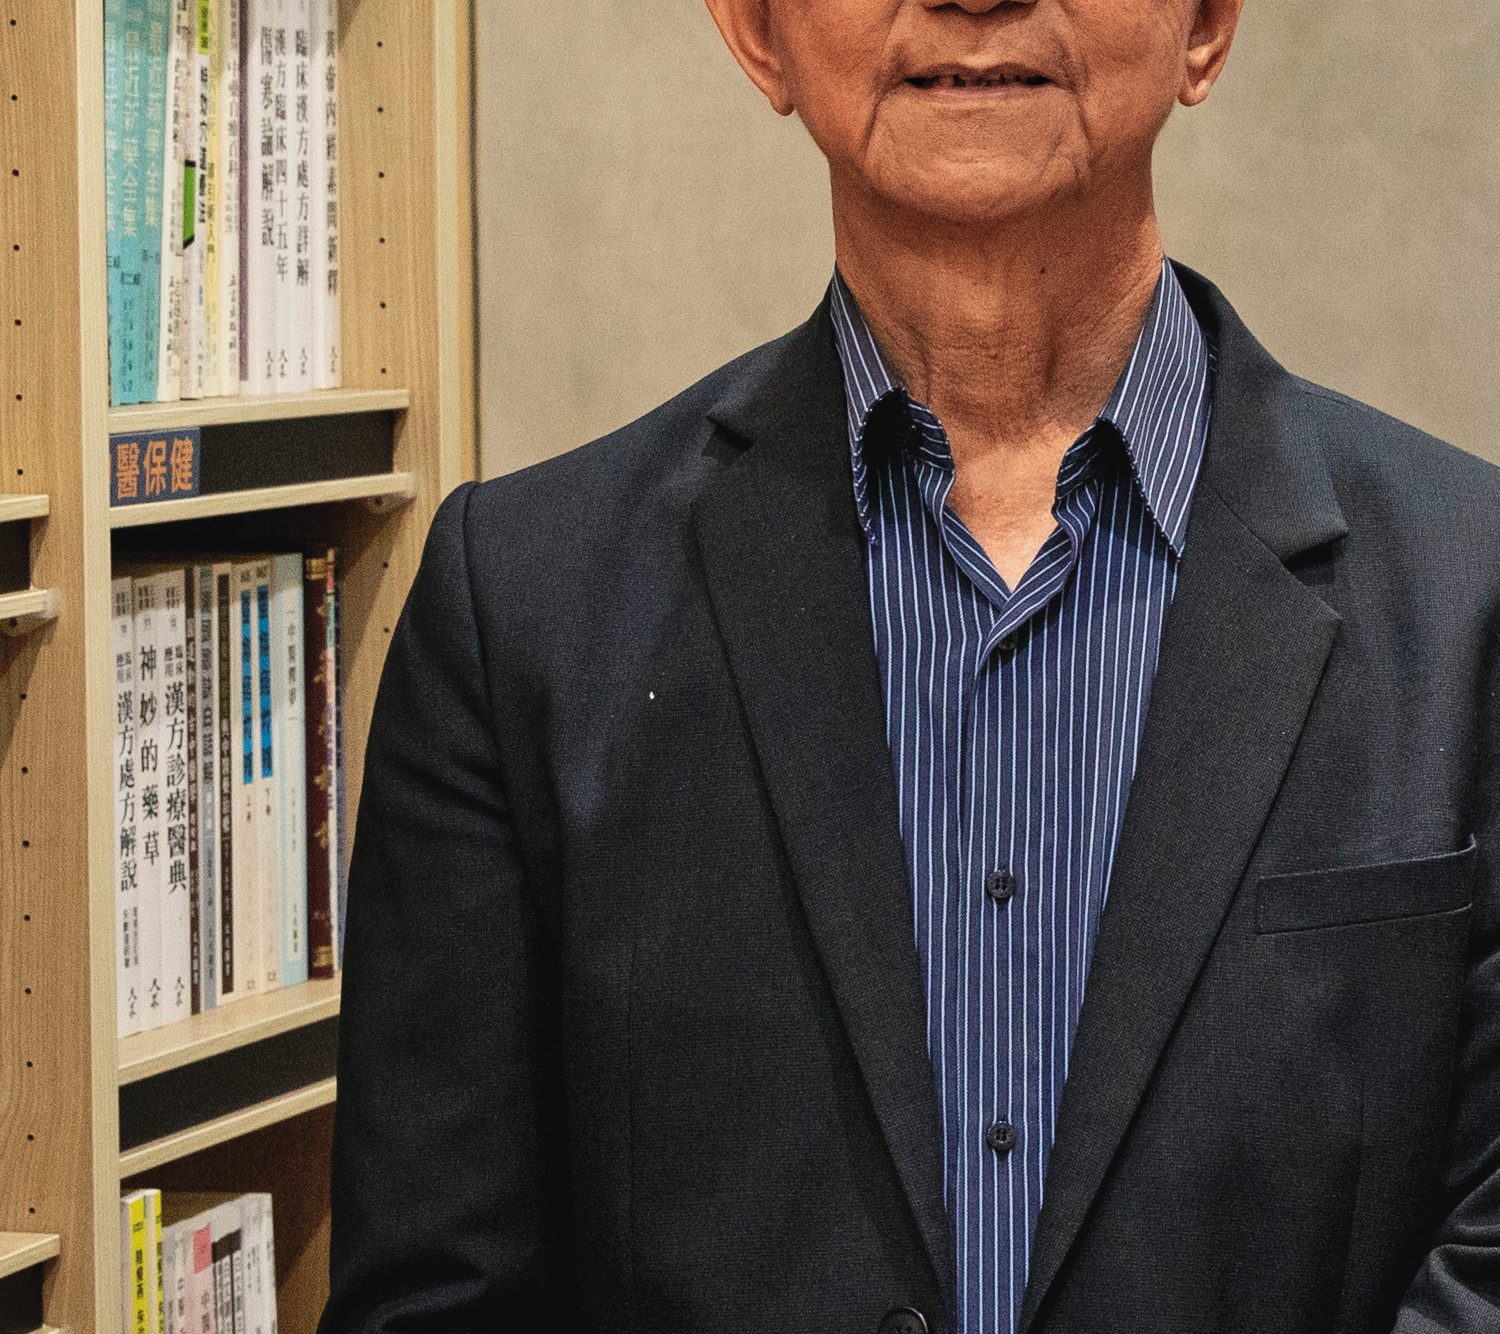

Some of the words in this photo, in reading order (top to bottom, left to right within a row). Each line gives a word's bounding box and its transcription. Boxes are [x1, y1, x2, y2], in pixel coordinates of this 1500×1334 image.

[108, 437, 195, 500] 醫保健
[117, 690, 138, 892] 漢方處方解說
[139, 645, 161, 866] 神妙的藥草
[164, 680, 188, 895] 漢方診療醫典
